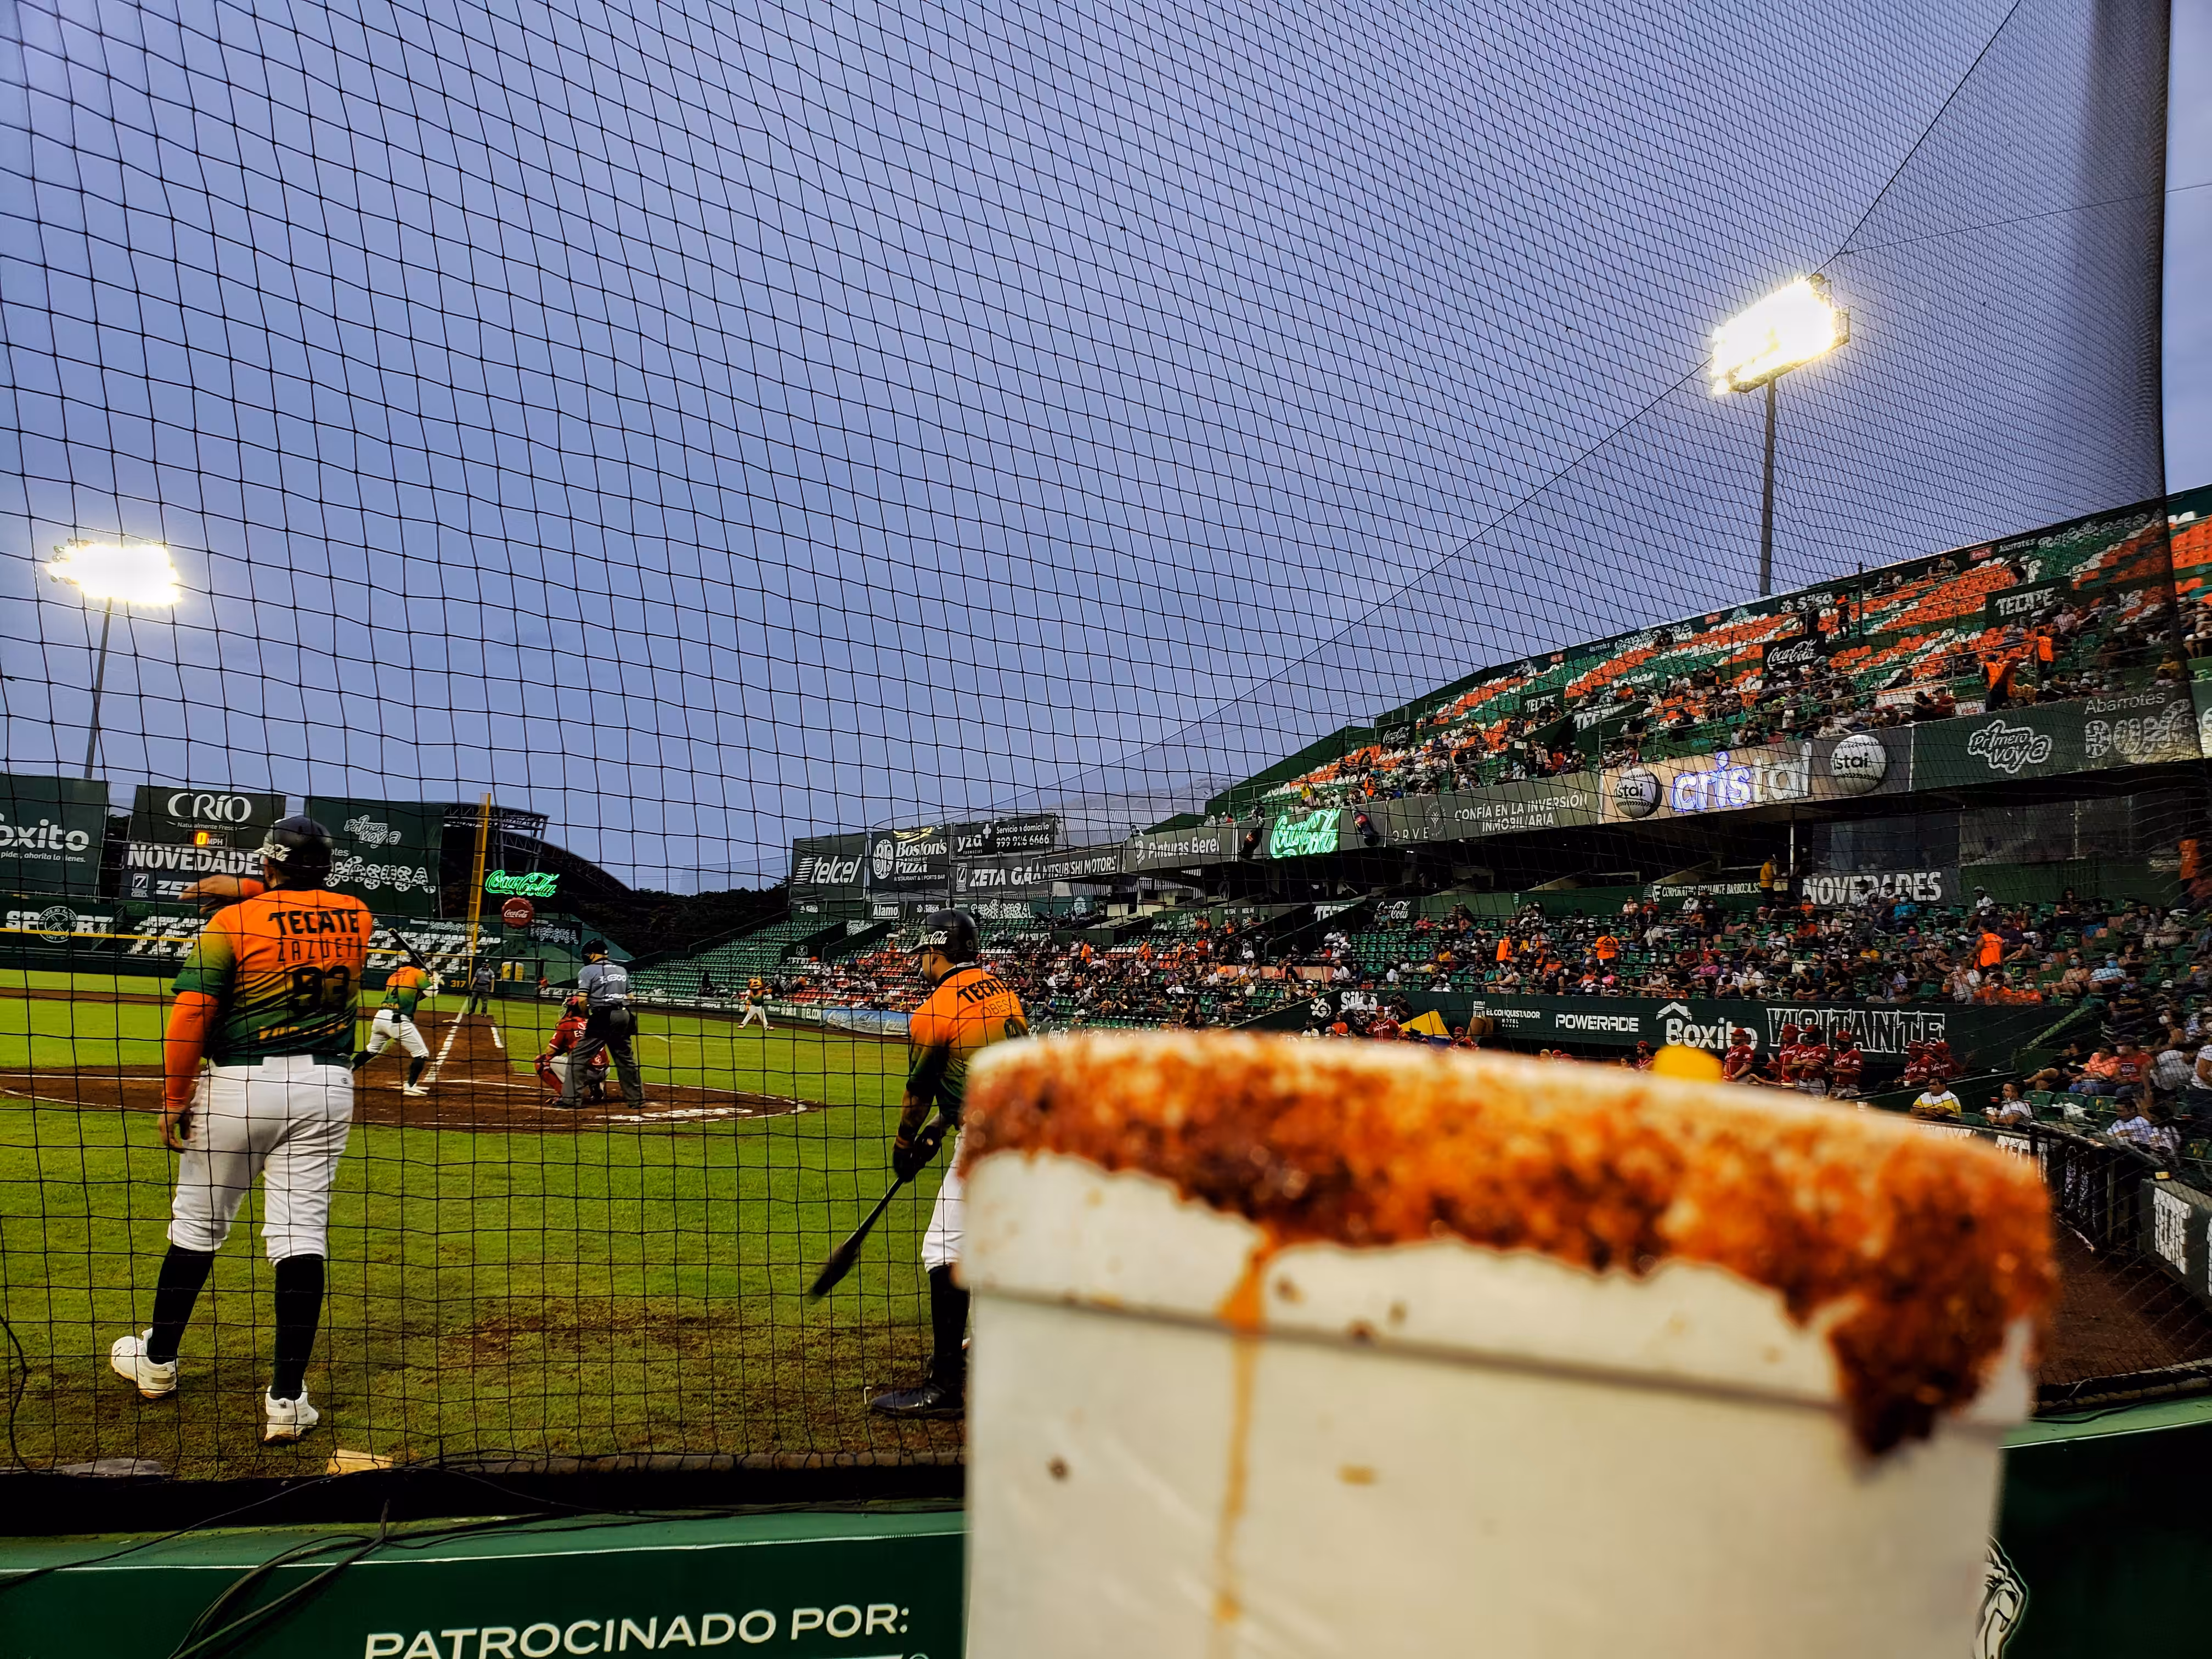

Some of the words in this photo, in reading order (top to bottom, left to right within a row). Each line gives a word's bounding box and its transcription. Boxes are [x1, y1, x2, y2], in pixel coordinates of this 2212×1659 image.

[2085, 692, 2166, 714] Abarrotes
[1671, 742, 1813, 812] cristal
[1454, 803, 1492, 821] CONFÍA
[1495, 803, 1508, 817] EN
[1511, 803, 1524, 815] LA
[1527, 791, 1588, 812] INVERSIÓN
[996, 826, 1018, 834] Servicio
[1023, 823, 1049, 832] domicilio
[196, 832, 206, 845] 0
[207, 837, 223, 845] MPH
[895, 838, 947, 857] Boston's
[957, 834, 983, 853] yza
[1029, 833, 1049, 846] 6666
[1148, 840, 1189, 859] Pinturas
[810, 854, 863, 883] telcel
[970, 868, 1006, 887] ZETA
[486, 870, 560, 898] Coca-Cola
[872, 905, 899, 916] Alamo
[268, 910, 360, 935] TECATE
[450, 980, 466, 988] 317
[1555, 1014, 1639, 1032] POWERADE
[364, 1609, 777, 1659] PATROCINADO
[790, 1602, 910, 1641] POR:
